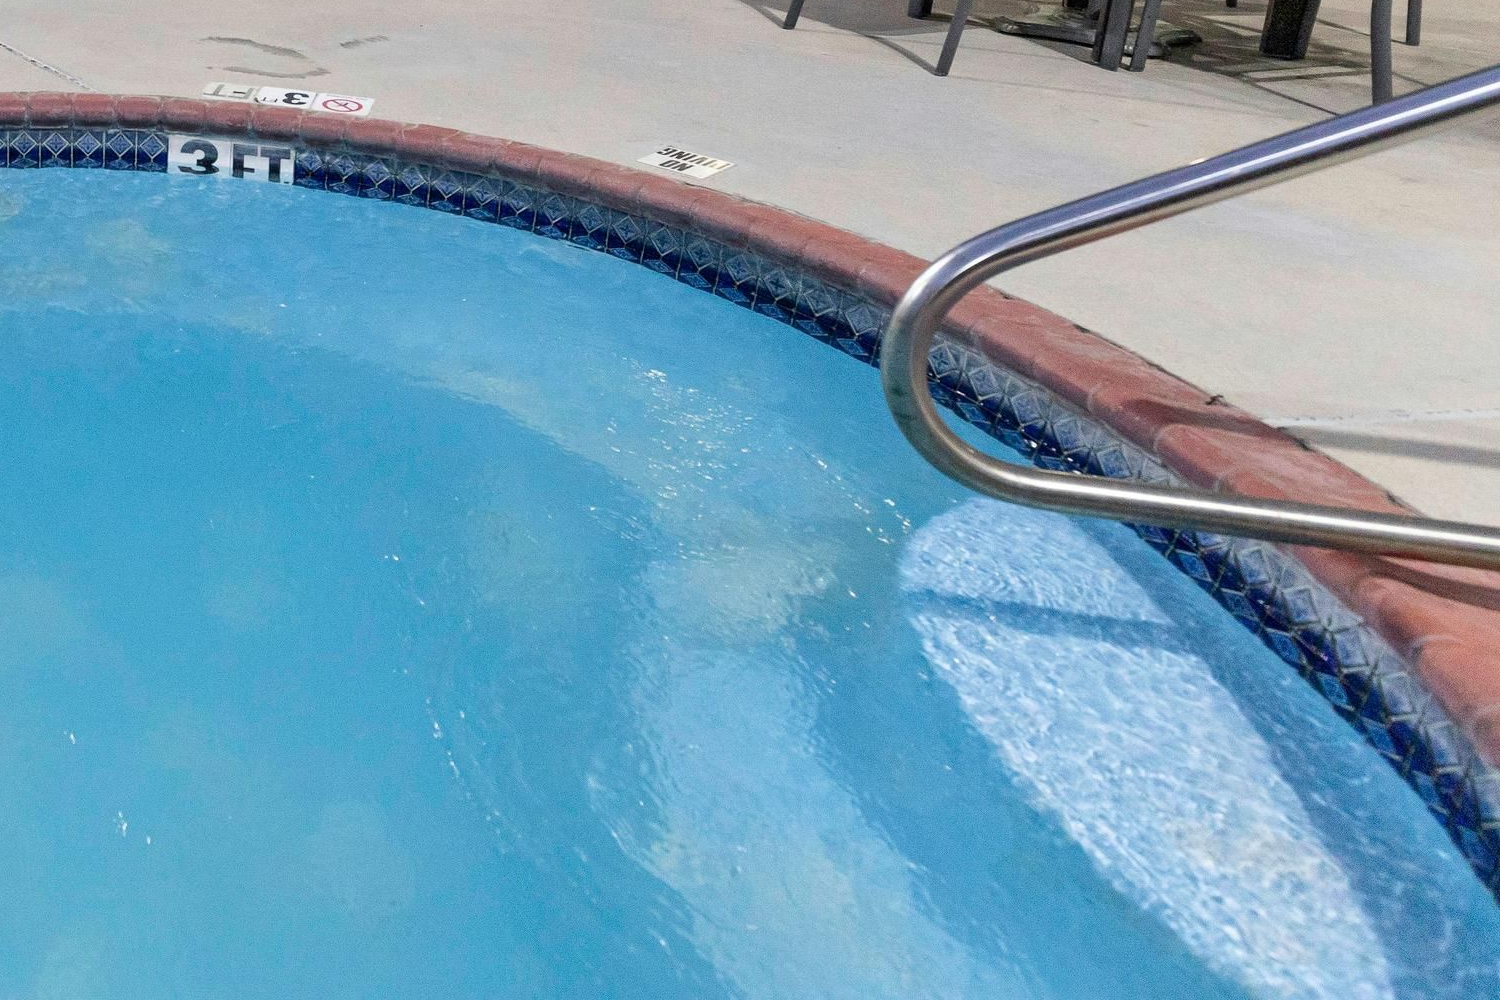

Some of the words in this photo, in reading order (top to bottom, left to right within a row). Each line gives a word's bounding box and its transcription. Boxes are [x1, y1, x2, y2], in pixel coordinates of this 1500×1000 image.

[282, 92, 310, 105] 3
[178, 139, 220, 175] 3
[232, 143, 291, 183] FT
[659, 159, 693, 171] NO
